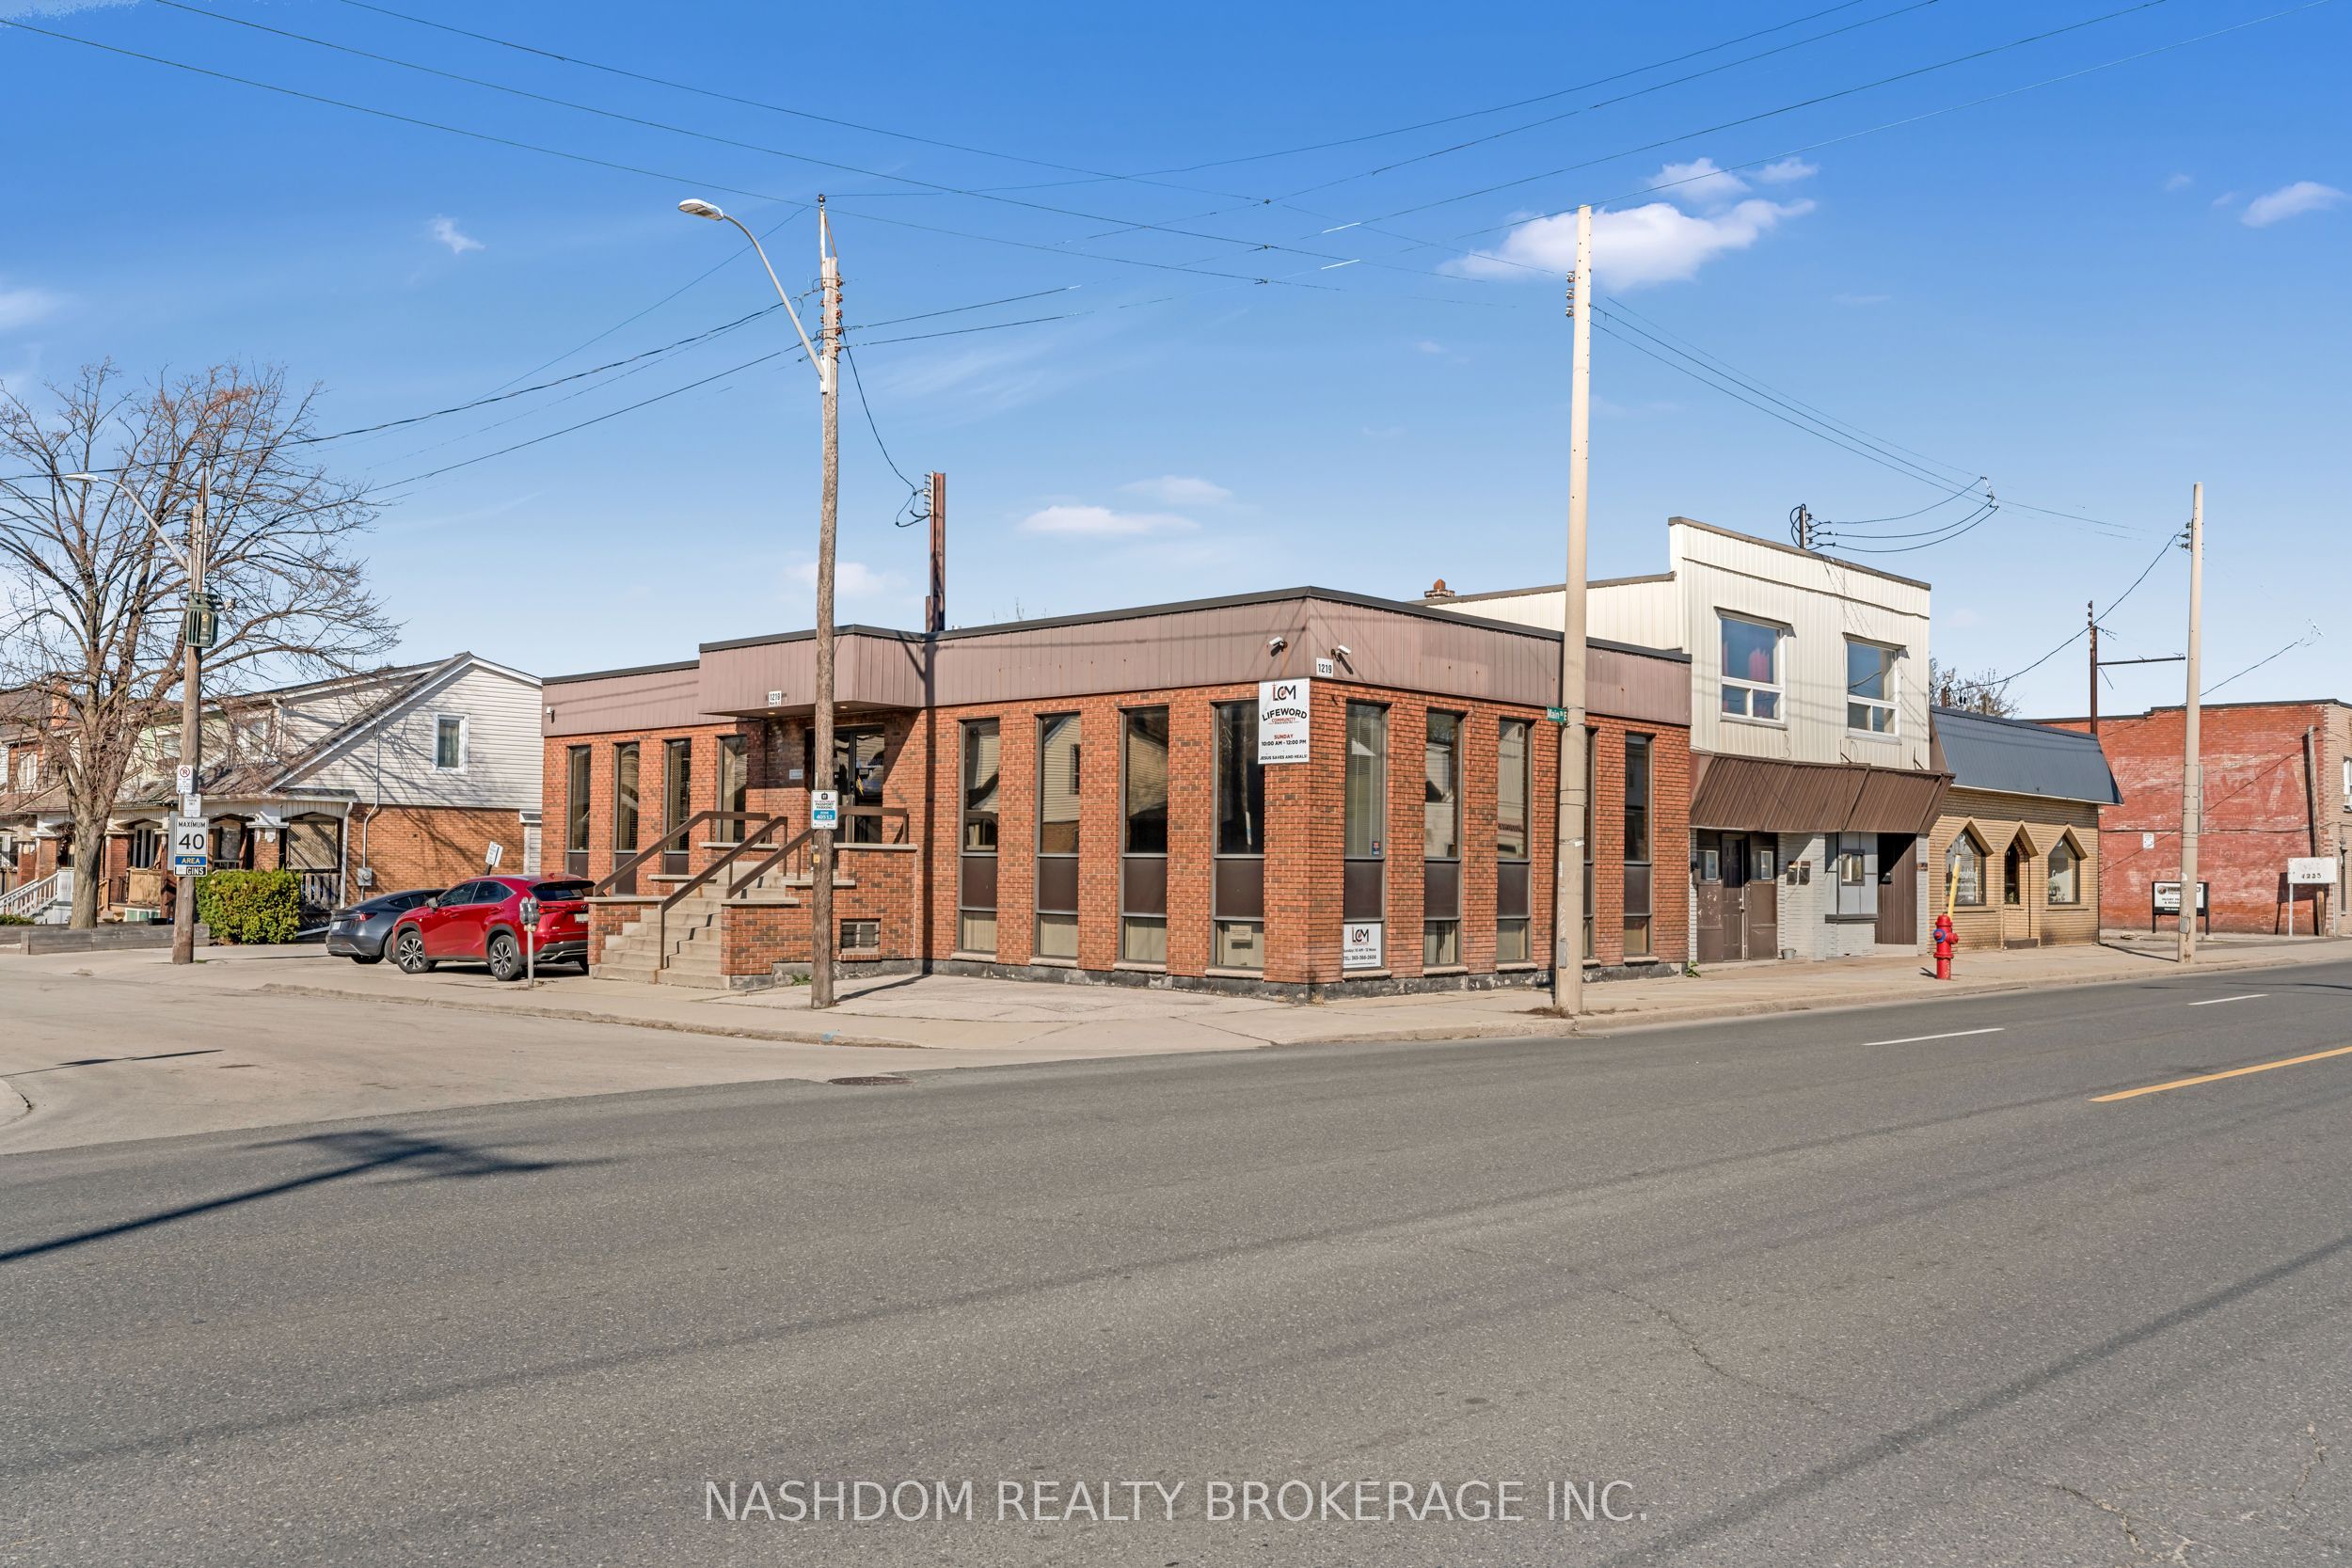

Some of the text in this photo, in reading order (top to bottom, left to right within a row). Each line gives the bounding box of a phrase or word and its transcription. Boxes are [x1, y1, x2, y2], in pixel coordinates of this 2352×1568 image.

[1318, 663, 1332, 673] 1219
[1272, 683, 1296, 701] LCM
[1262, 708, 1307, 721] LIFEWORD
[179, 833, 204, 849] 40
[186, 866, 204, 875] GINS
[1352, 927, 1369, 942] LCM
